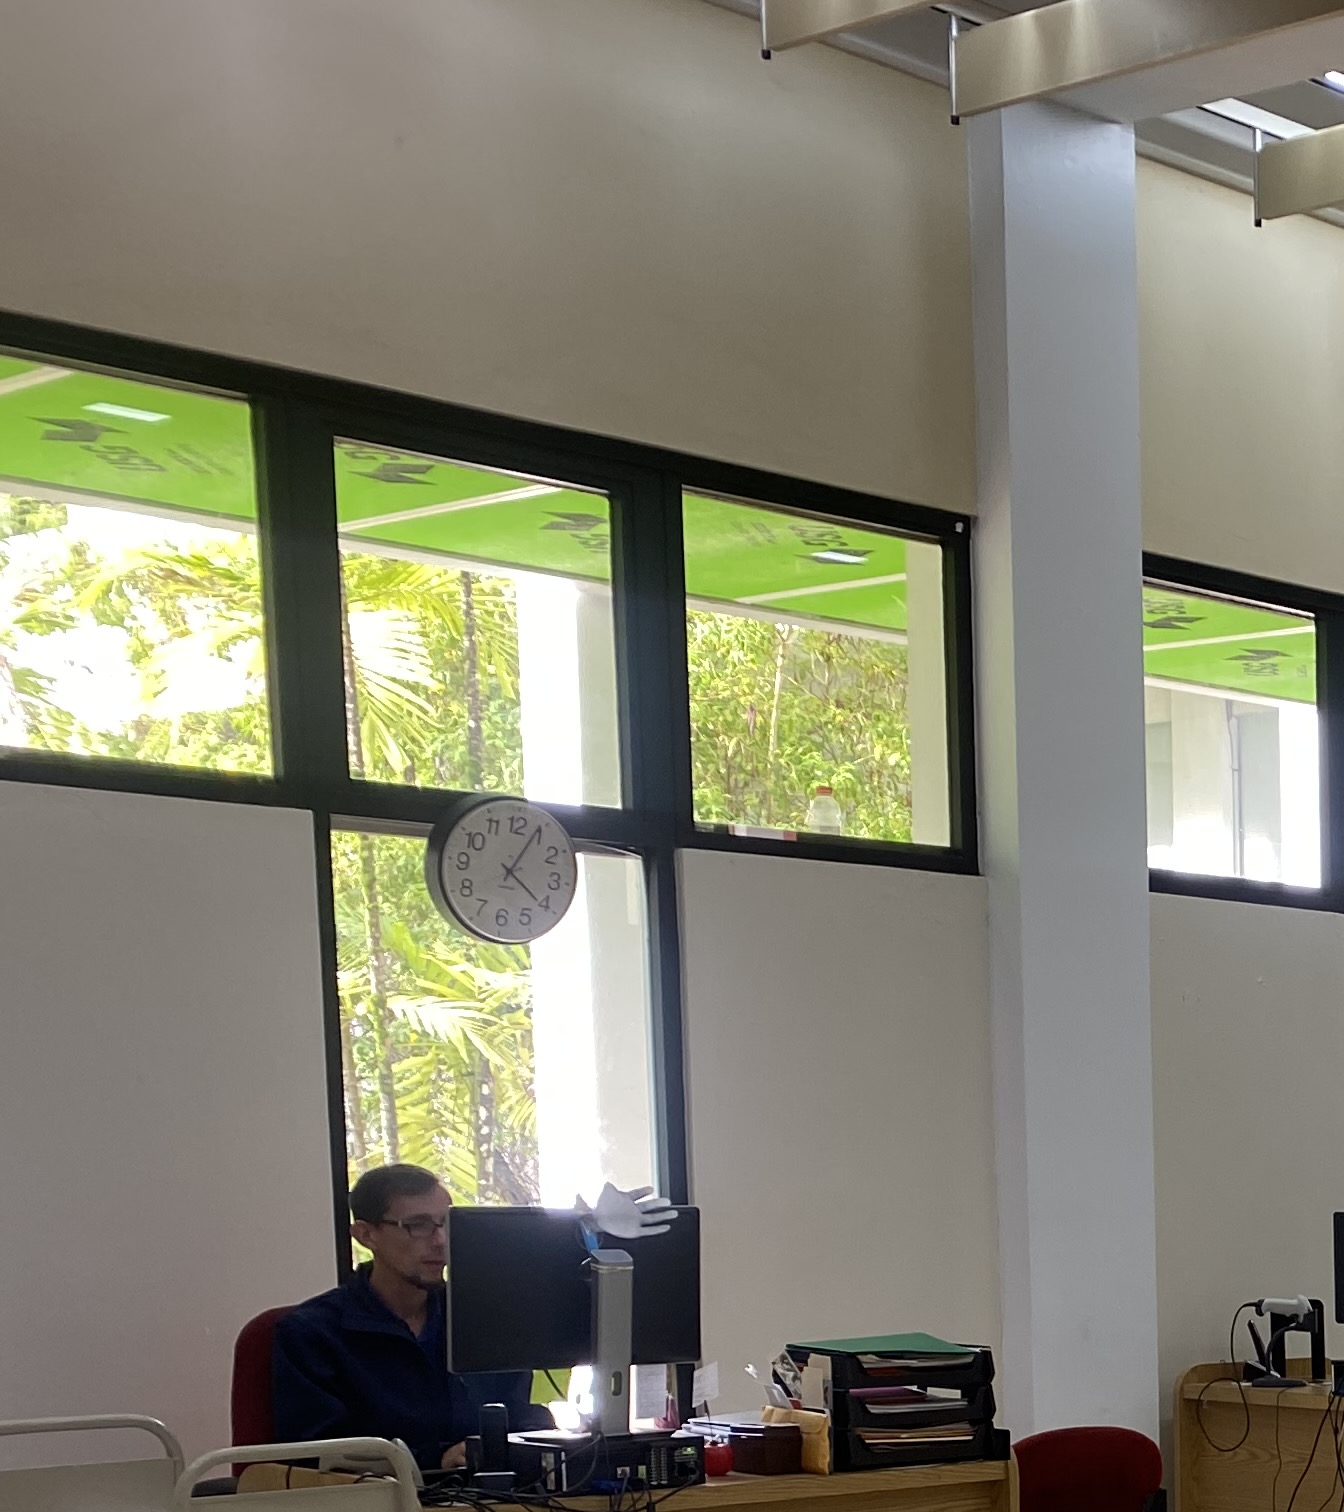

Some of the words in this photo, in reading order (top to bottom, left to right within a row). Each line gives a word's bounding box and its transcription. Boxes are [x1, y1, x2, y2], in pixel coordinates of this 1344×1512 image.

[486, 818, 499, 836] 11
[507, 816, 527, 836] 12
[465, 832, 486, 851] 10
[456, 852, 470, 870] 9
[544, 846, 558, 864] 2
[460, 878, 473, 897] 8
[548, 872, 561, 890] 3
[476, 898, 488, 916] 7
[538, 895, 550, 912] 4
[496, 908, 509, 926] 6
[519, 908, 532, 926] 5
